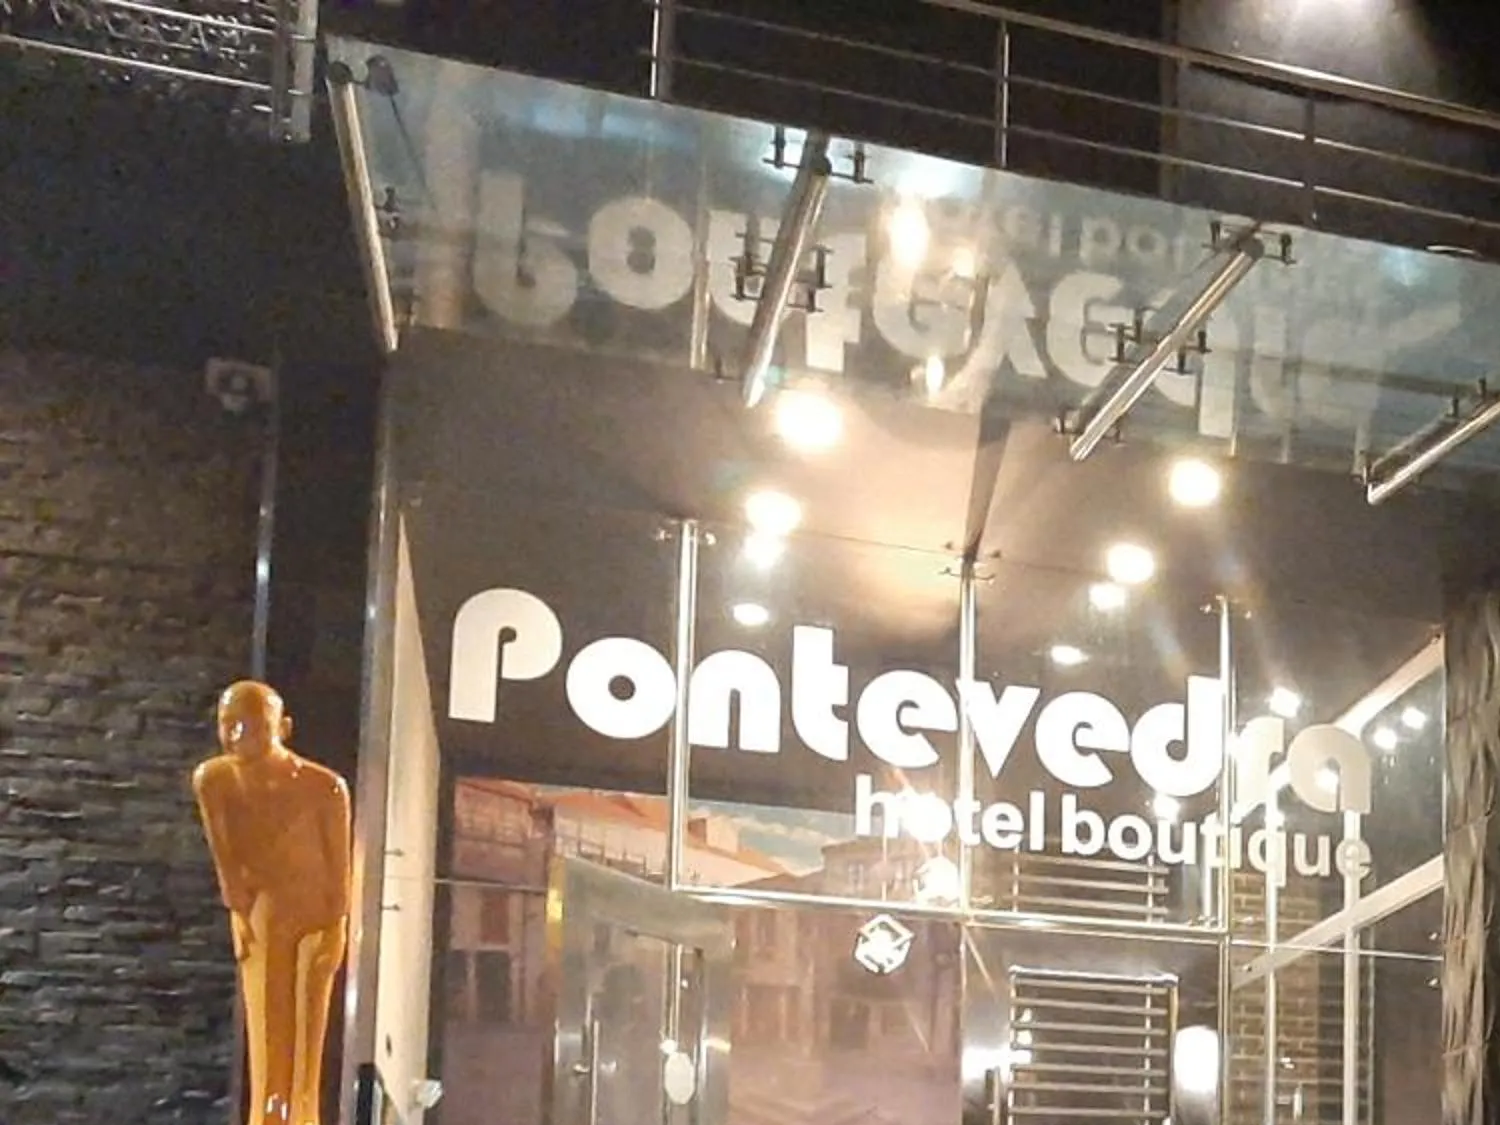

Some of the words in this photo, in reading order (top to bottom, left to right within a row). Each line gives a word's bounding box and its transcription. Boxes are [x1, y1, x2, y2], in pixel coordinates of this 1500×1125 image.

[449, 587, 1372, 815] Pontevedra
[855, 773, 1046, 852] hotel
[1061, 793, 1373, 888] boutique
